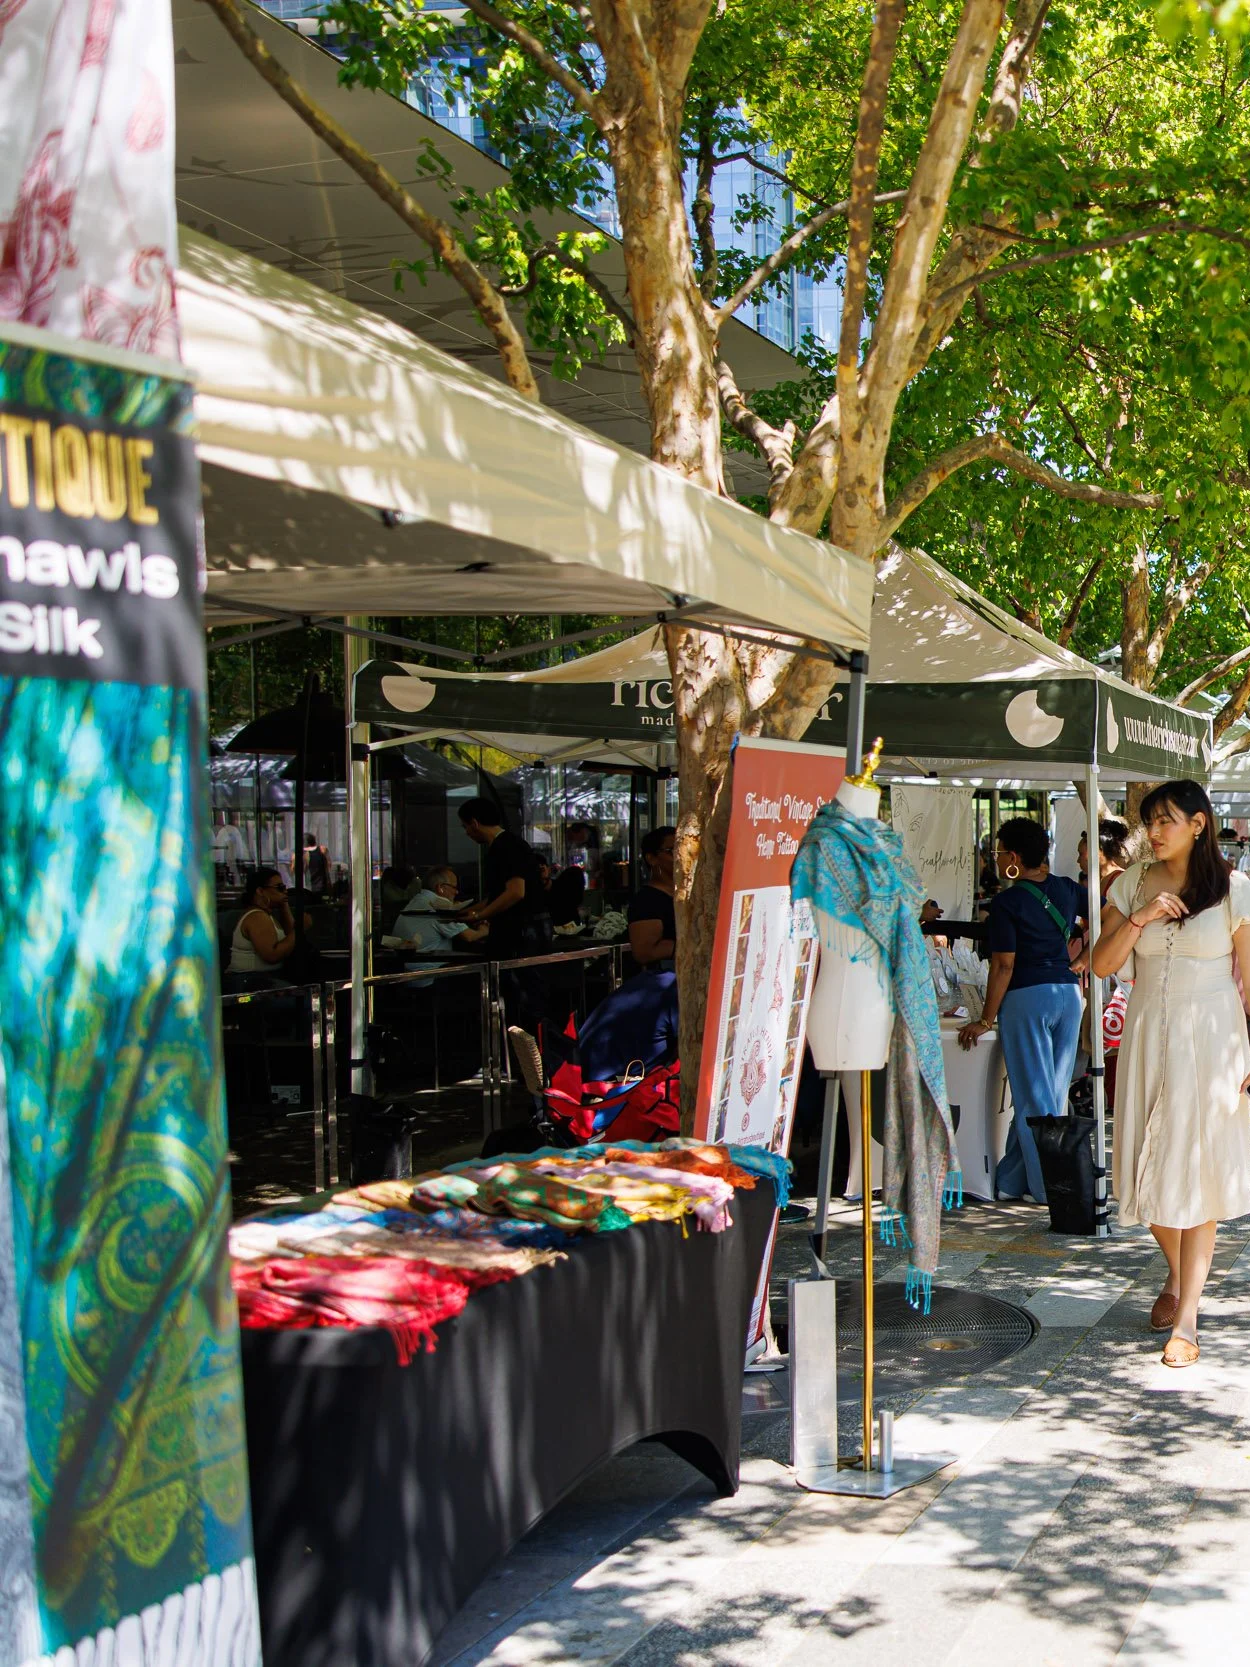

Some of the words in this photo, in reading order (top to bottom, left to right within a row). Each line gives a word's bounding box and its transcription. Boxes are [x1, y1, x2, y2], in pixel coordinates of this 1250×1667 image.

[0, 413, 160, 526] TIQUE
[611, 681, 676, 709] ric
[641, 713, 675, 727] mad
[783, 793, 814, 827] Vintage
